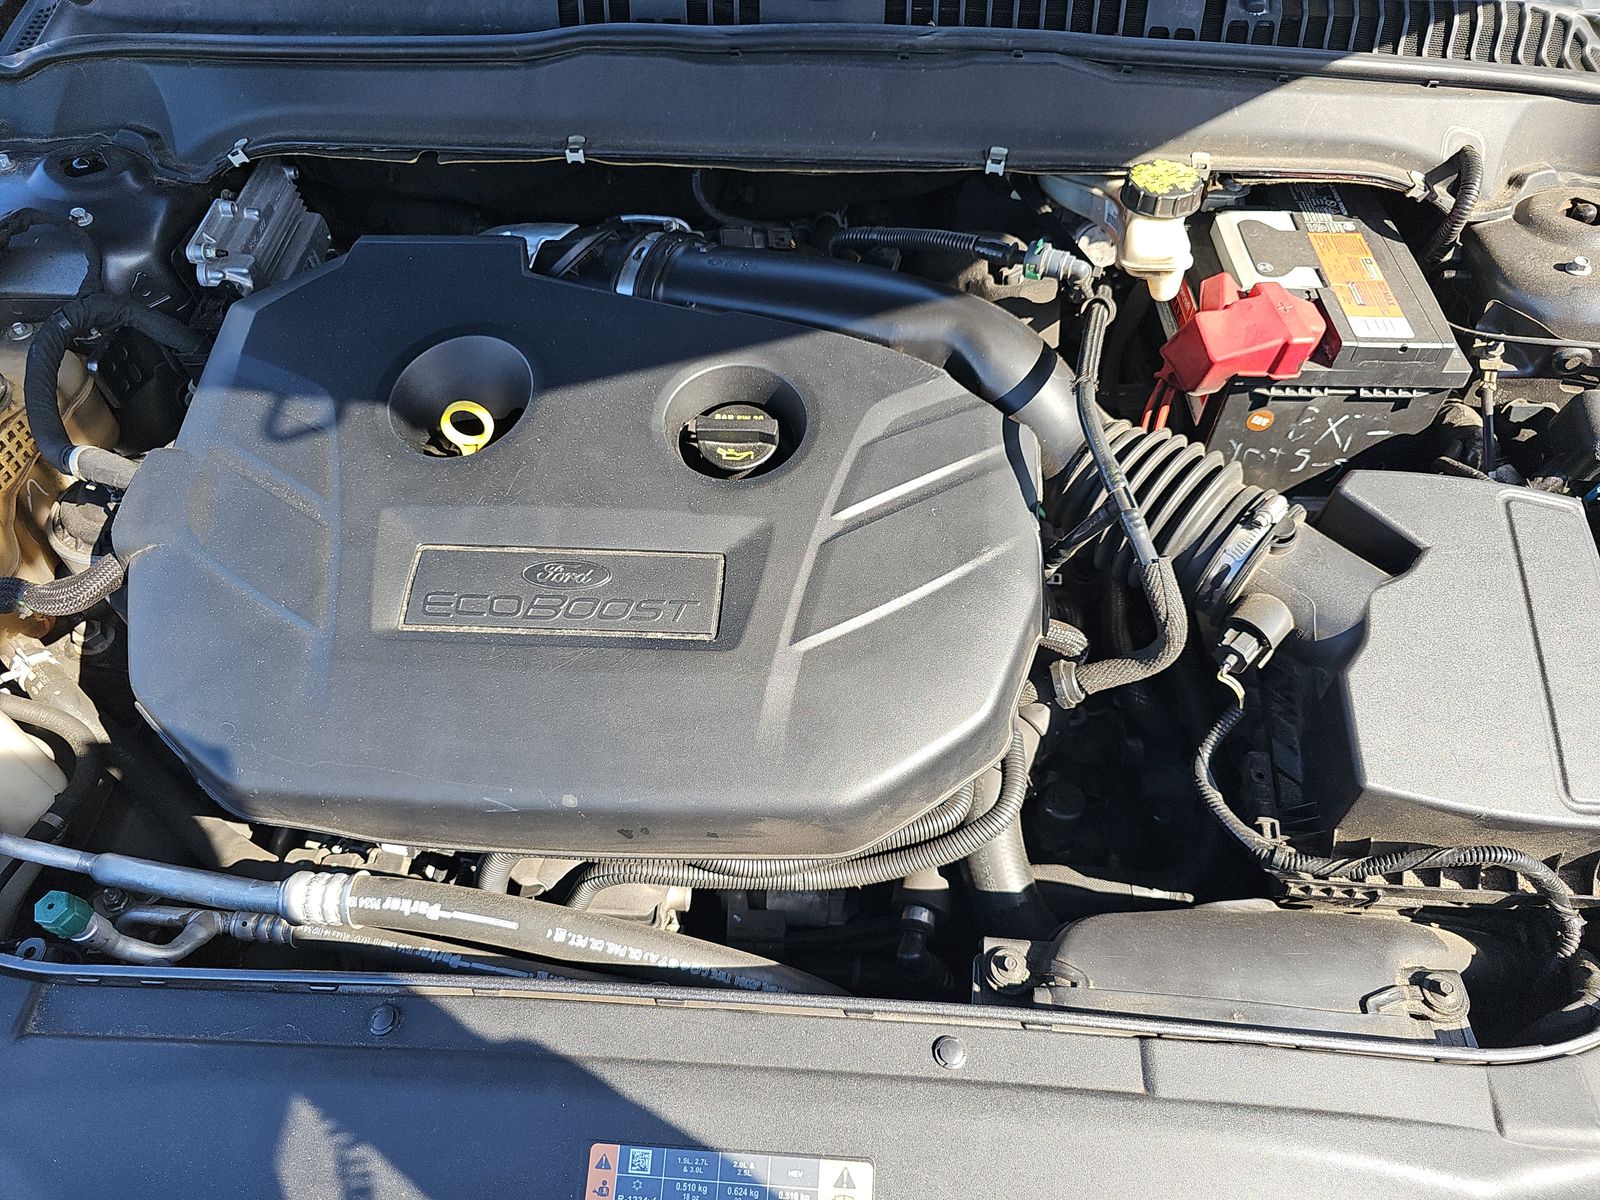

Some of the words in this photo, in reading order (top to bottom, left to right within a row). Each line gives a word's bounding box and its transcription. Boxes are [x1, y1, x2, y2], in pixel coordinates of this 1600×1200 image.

[536, 563, 593, 584] Ford
[421, 592, 702, 623] ECOBOOST
[381, 896, 441, 921] Parker
[414, 946, 462, 969] Parker
[694, 1158, 709, 1166] 2.7L
[733, 1160, 748, 1169] 2.0L
[690, 1166, 704, 1174] 3.0L
[737, 1168, 752, 1177] 2.5L
[676, 1182, 696, 1192] 0.510
[698, 1184, 708, 1195] kg
[727, 1186, 748, 1196] 0.624
[749, 1187, 759, 1199] kg
[778, 1190, 798, 1200] 0.510
